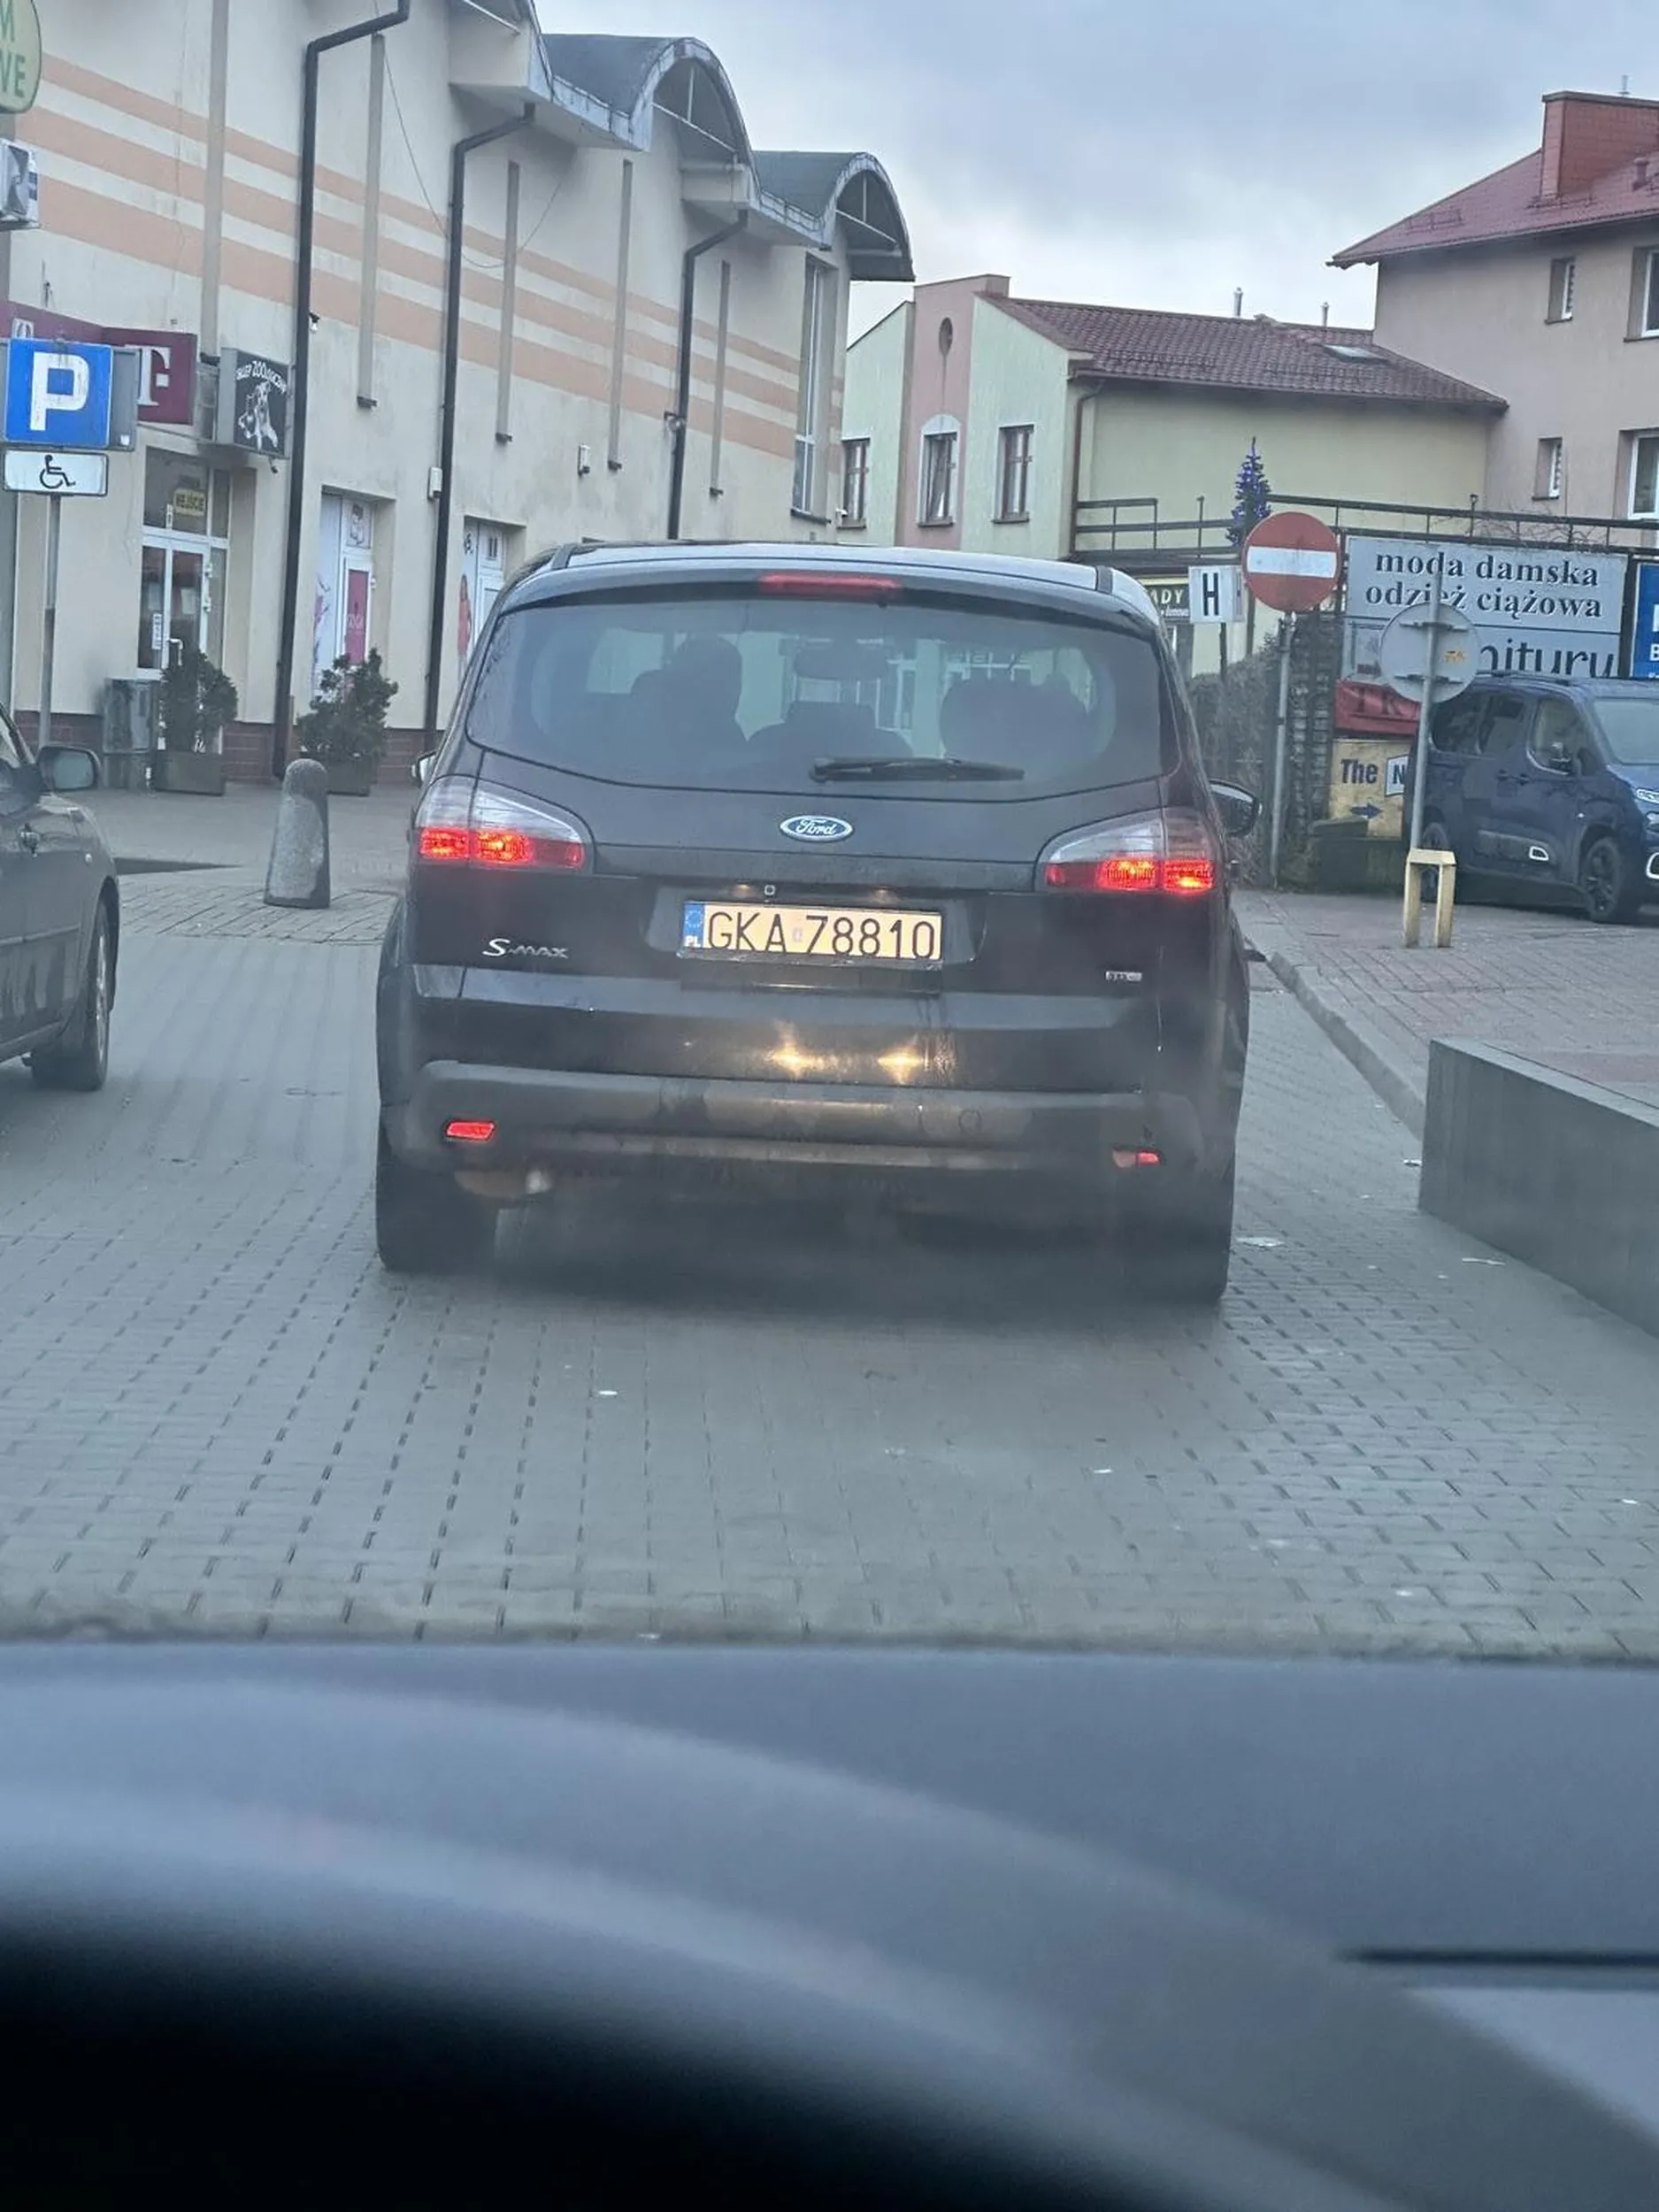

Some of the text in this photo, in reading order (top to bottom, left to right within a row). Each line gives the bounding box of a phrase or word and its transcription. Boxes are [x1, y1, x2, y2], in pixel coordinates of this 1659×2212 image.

[30, 351, 89, 431] P
[1376, 551, 1599, 587] moda damska
[1202, 572, 1219, 616] H
[1477, 588, 1602, 619] ciążowa
[1340, 758, 1379, 785] The
[796, 818, 837, 835] Ford
[684, 934, 702, 948] PL
[709, 911, 935, 960] GKA 78810
